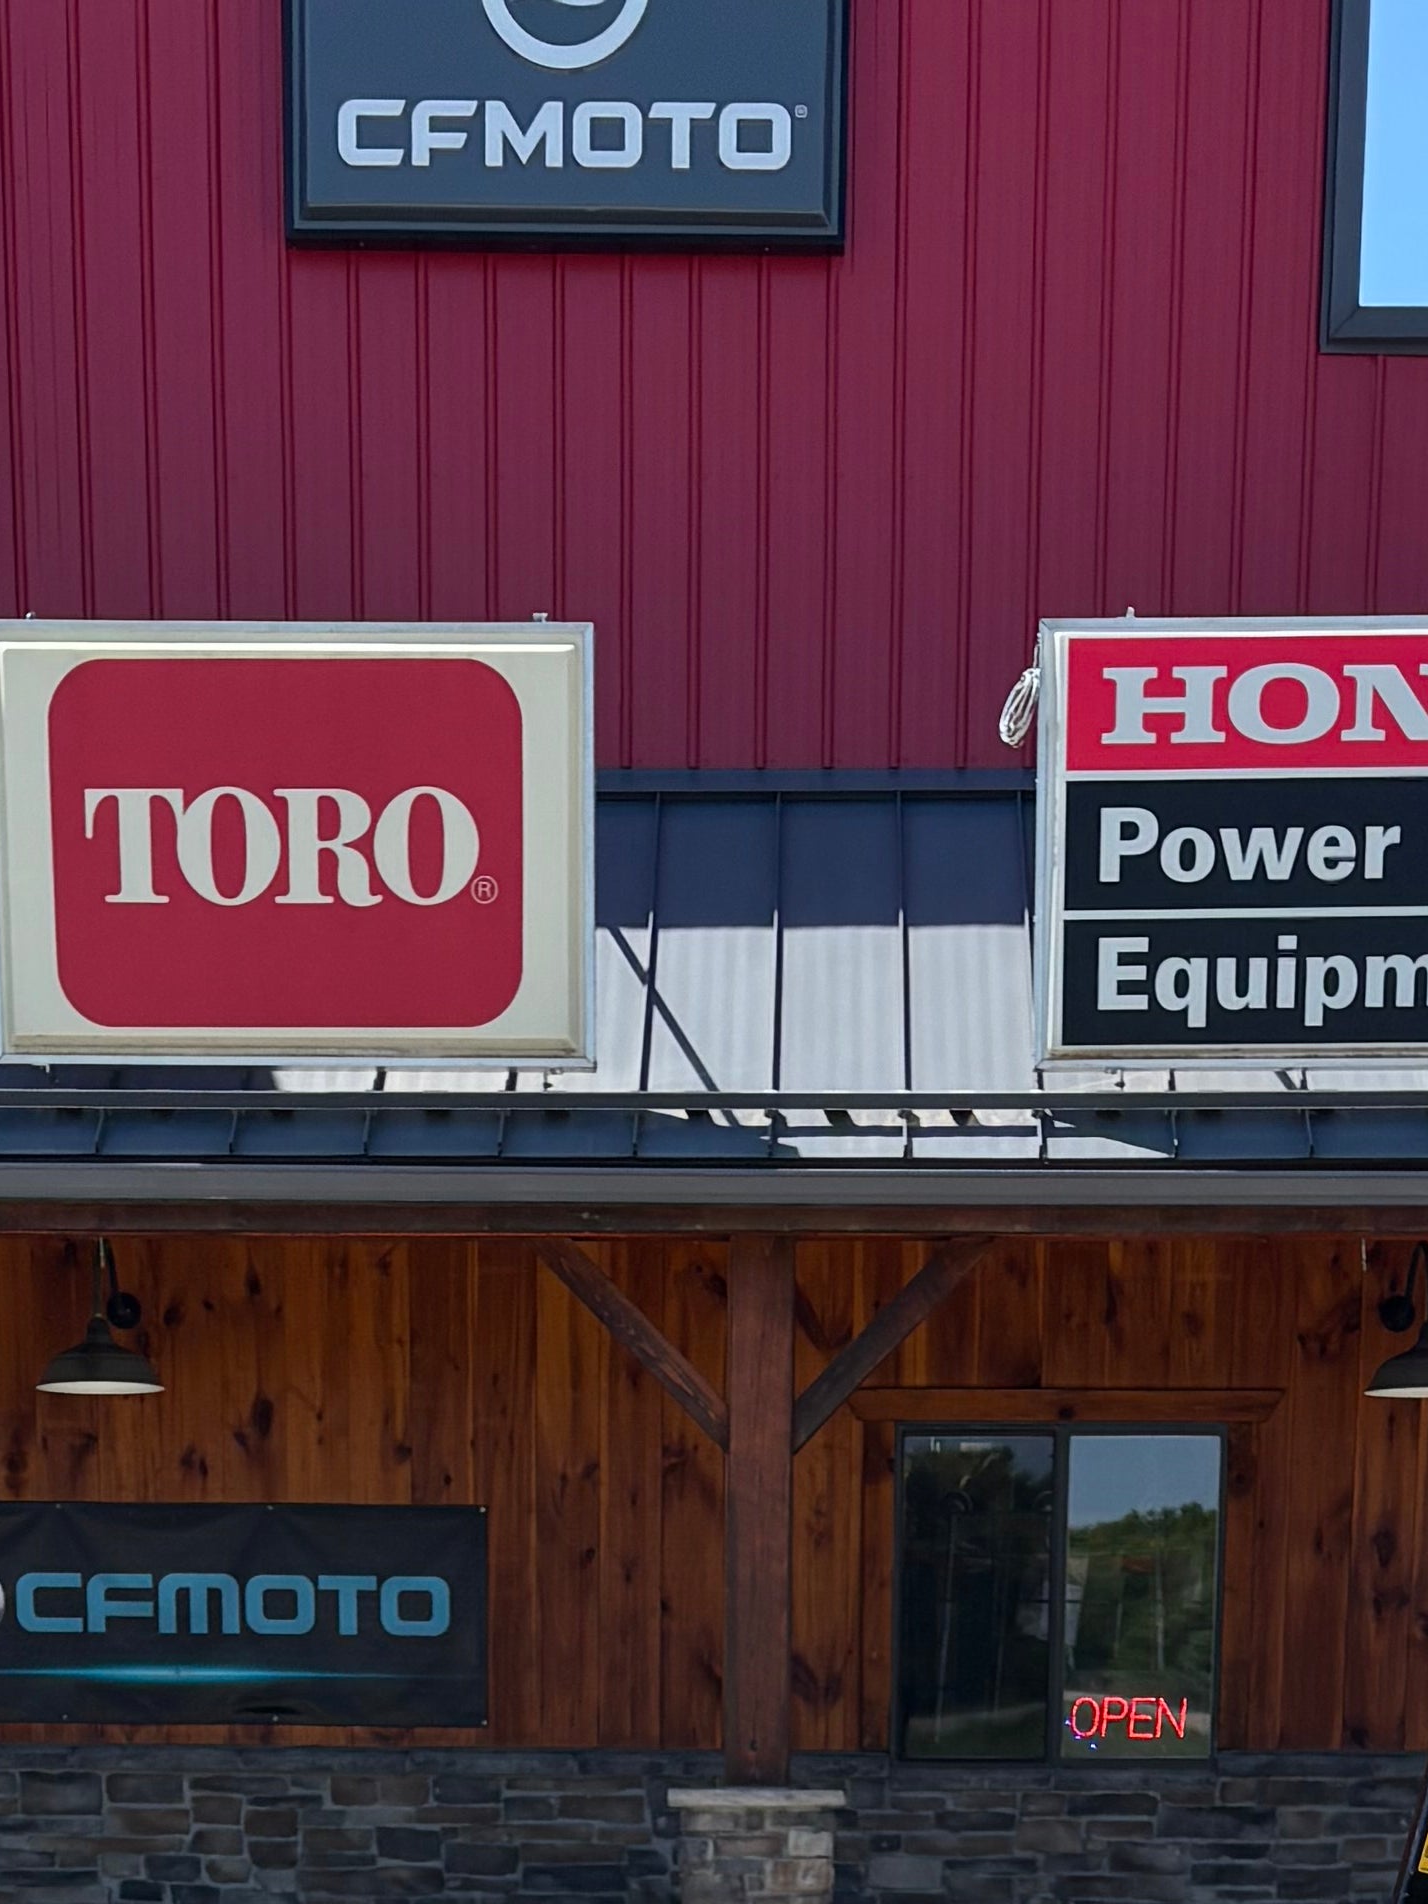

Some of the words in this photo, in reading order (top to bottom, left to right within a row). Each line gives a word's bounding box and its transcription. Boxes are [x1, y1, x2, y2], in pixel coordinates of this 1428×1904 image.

[1098, 806, 1402, 884] Power
[15, 1571, 451, 1638] CFMOTO
[1069, 1696, 1189, 1741] OPEN
